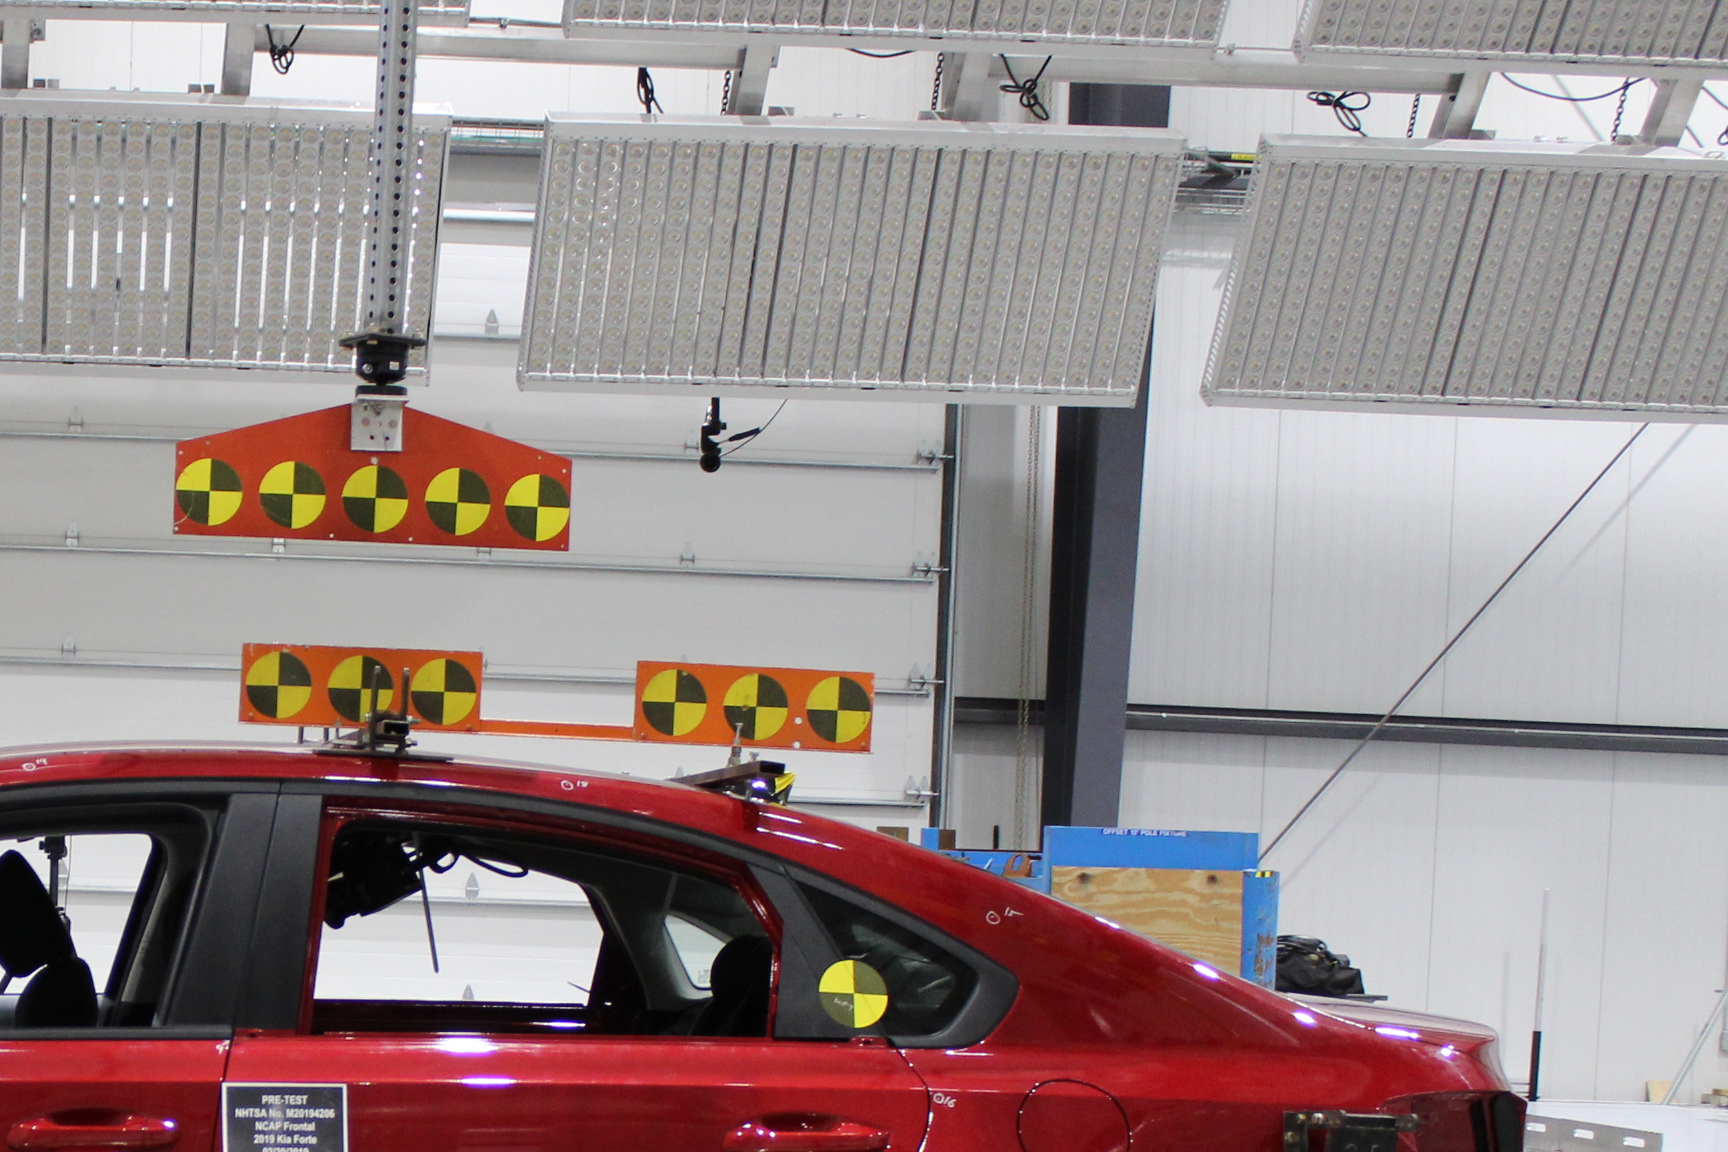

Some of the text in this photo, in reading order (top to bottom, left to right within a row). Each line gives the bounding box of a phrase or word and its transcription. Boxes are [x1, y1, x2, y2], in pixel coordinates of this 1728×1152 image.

[261, 1095, 308, 1105] PRE-TEST
[235, 1108, 336, 1119] NHTSA No. M20194206
[255, 1121, 316, 1131] NCAP Frontal
[253, 1134, 318, 1145] 2019 Kia Forte
